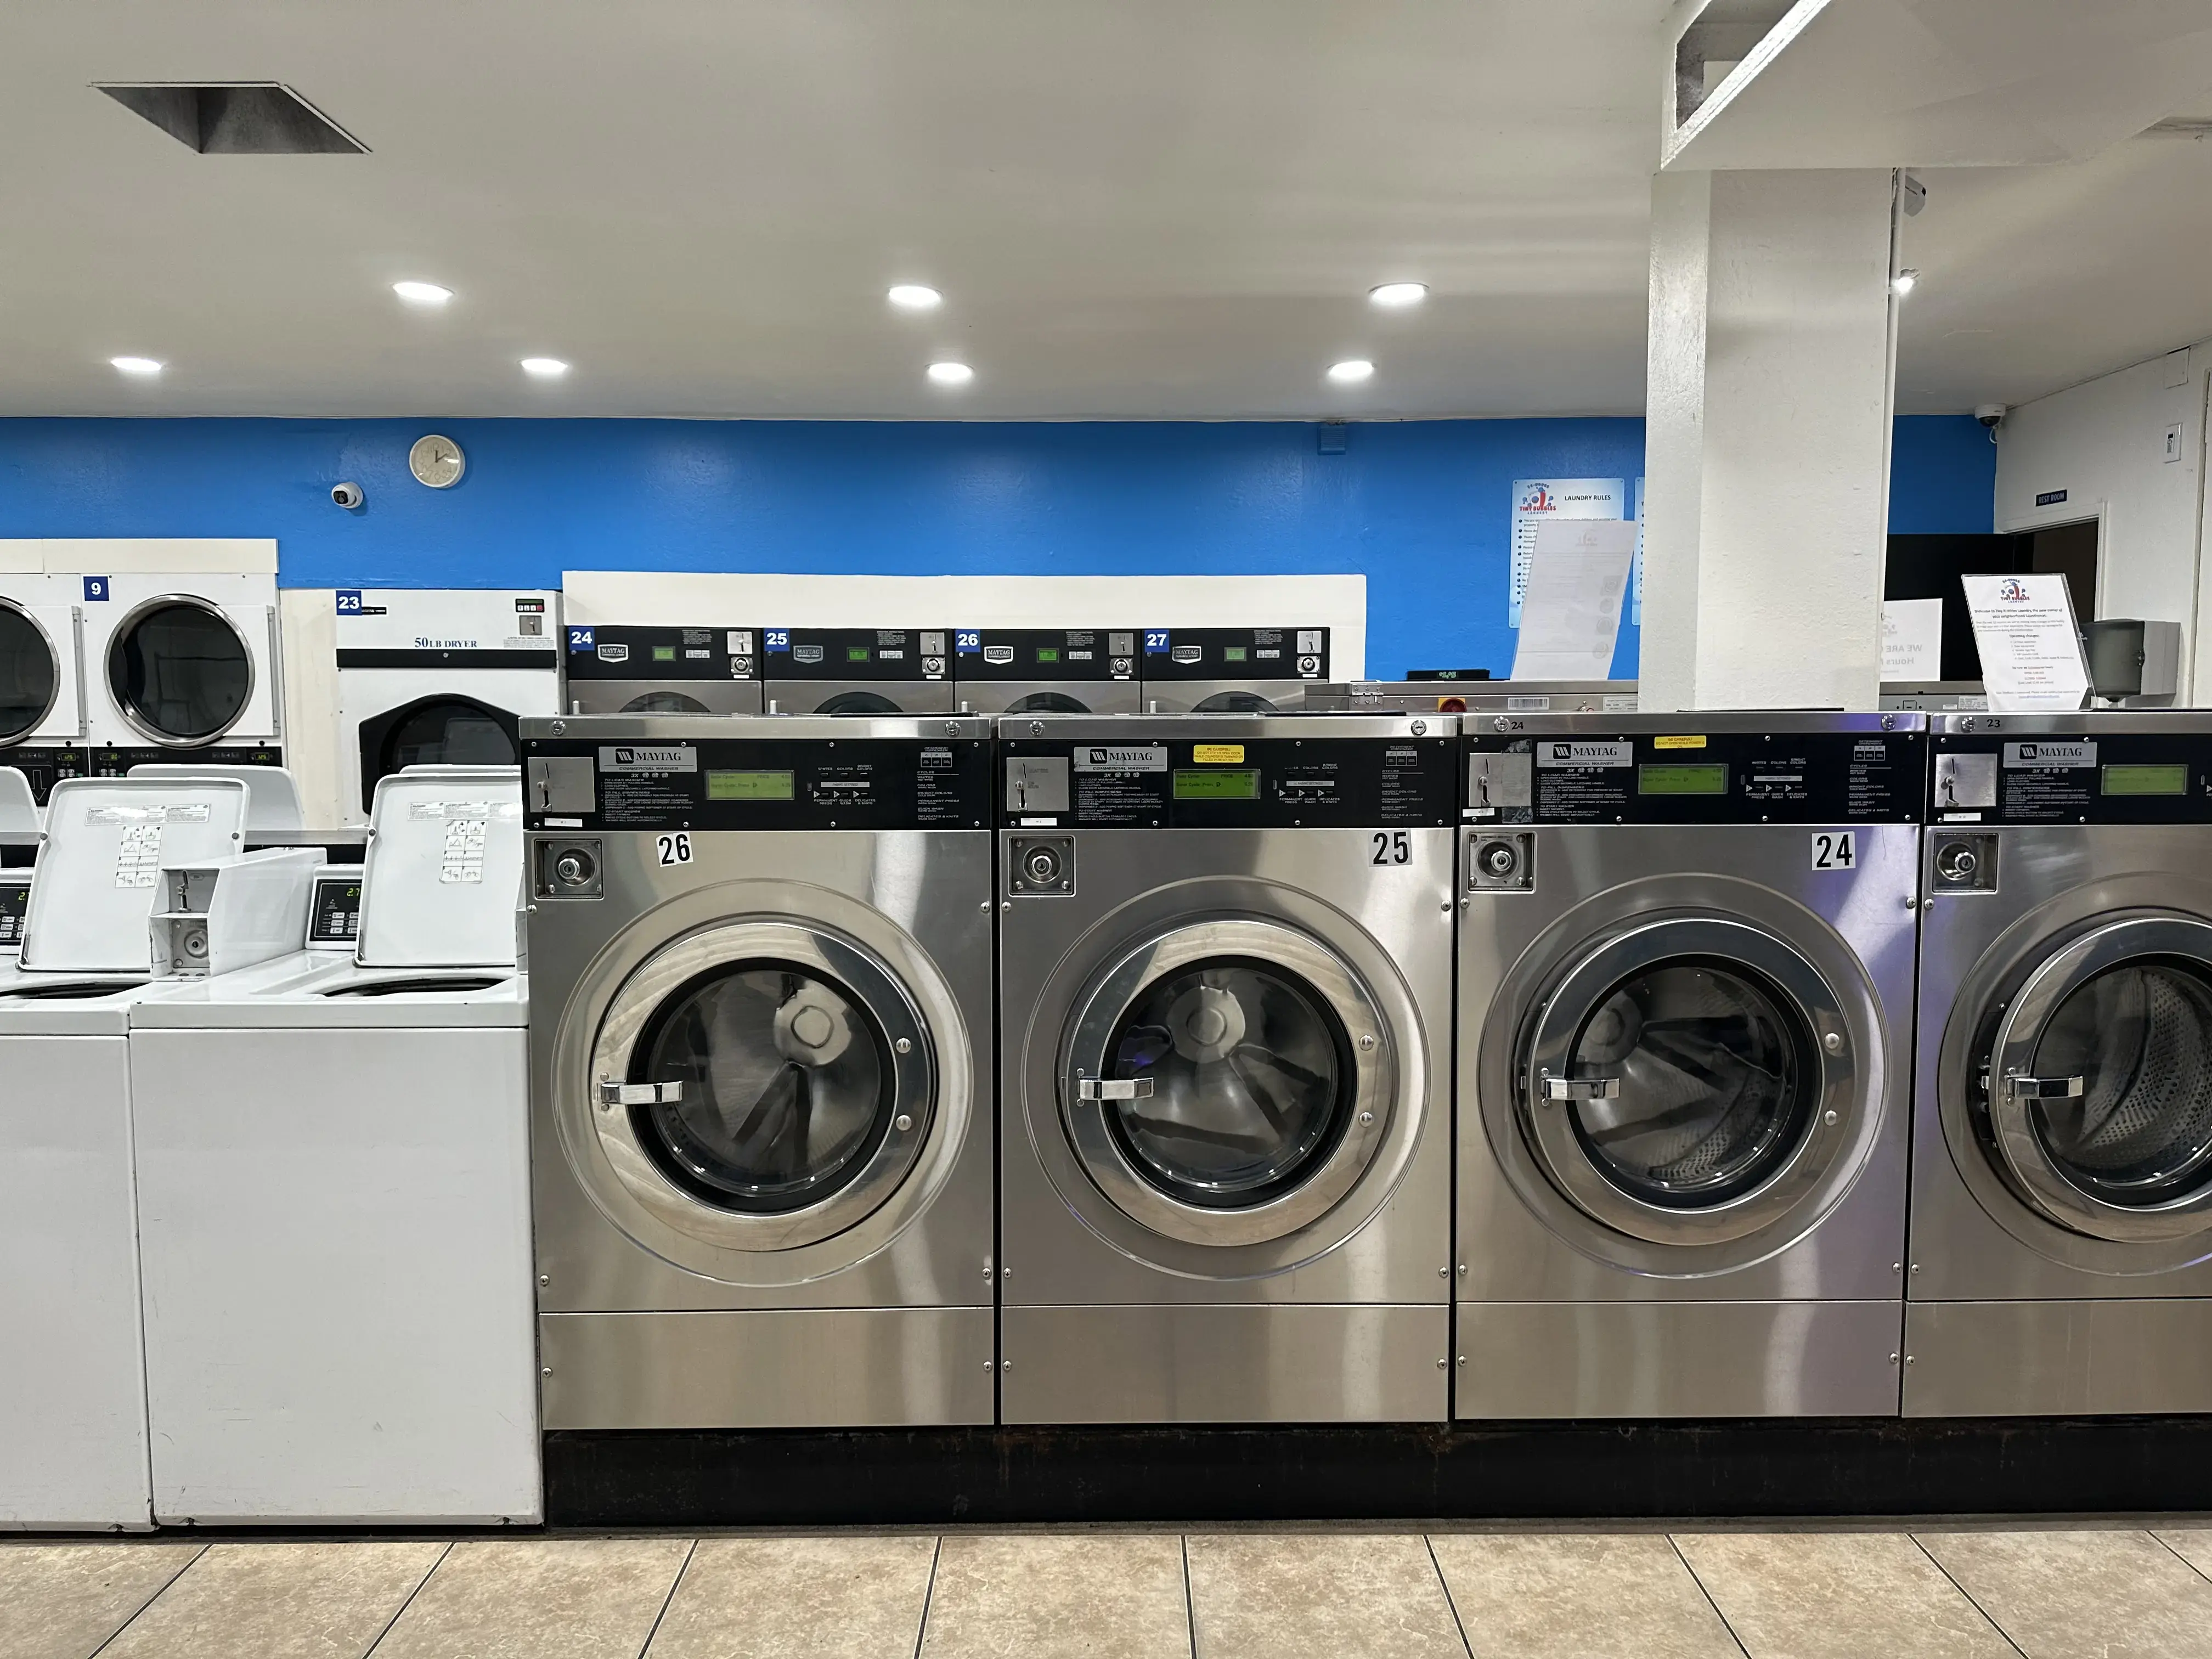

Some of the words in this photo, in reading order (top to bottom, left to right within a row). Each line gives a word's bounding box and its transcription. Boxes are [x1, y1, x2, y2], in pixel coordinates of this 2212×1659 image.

[2038, 495, 2050, 504] REST
[2051, 493, 2064, 502] ROOM
[91, 583, 102, 595] 9
[338, 596, 359, 610] 23
[571, 631, 592, 644] 24
[766, 633, 787, 645] 25
[958, 634, 978, 646] 26
[1147, 634, 1167, 646] 27
[444, 640, 477, 648] DRYER
[1511, 721, 1523, 730] 24
[1987, 719, 2000, 728] 23
[636, 752, 681, 761] MAYTAG
[1109, 752, 1152, 761] MAYTAG
[1573, 747, 1617, 756] MAYTAG
[2039, 747, 2082, 756] MAYTAG
[659, 835, 691, 864] 26
[1373, 831, 1409, 865] 25
[1816, 834, 1853, 867] 24
